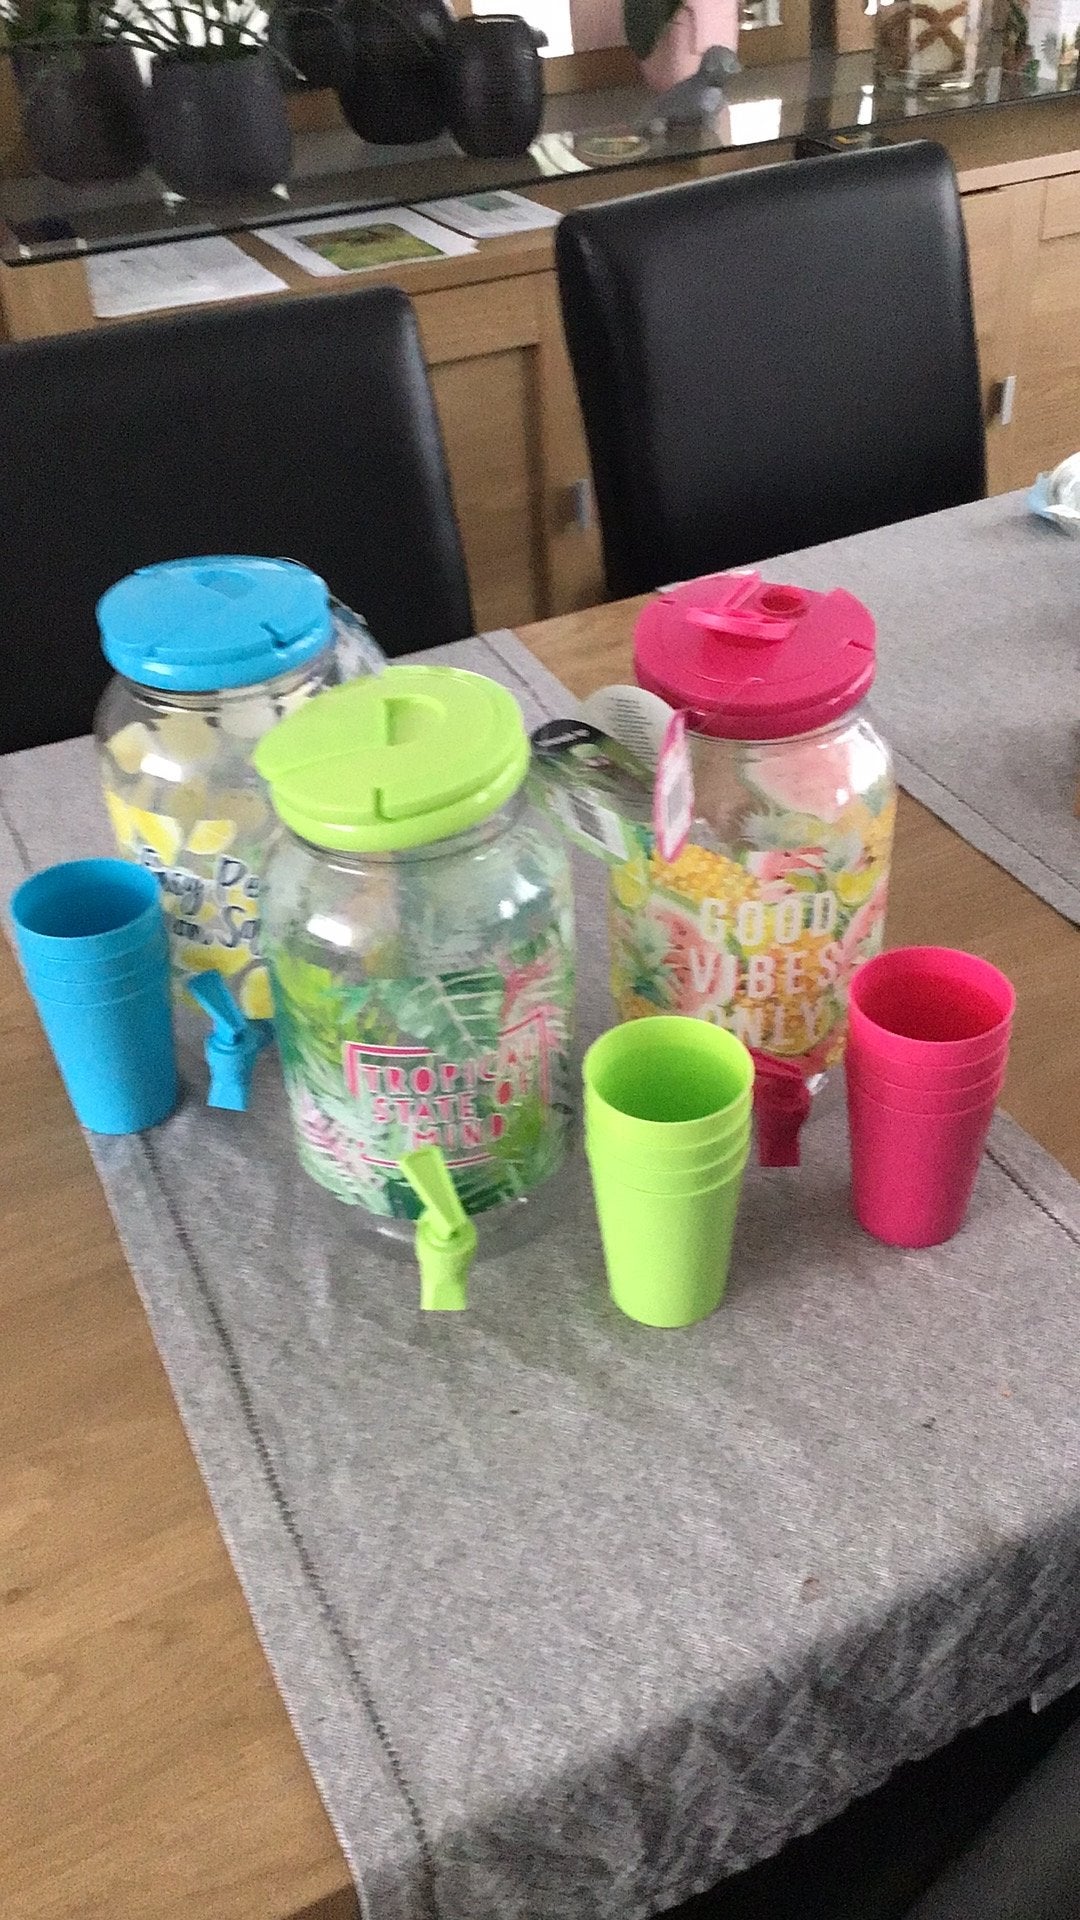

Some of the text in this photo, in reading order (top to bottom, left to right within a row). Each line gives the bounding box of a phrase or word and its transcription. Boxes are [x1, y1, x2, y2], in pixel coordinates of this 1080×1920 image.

[701, 892, 836, 945] GOOD
[690, 942, 844, 1002] VIBES
[373, 1091, 480, 1124] STATE
[412, 1112, 508, 1150] MIND
